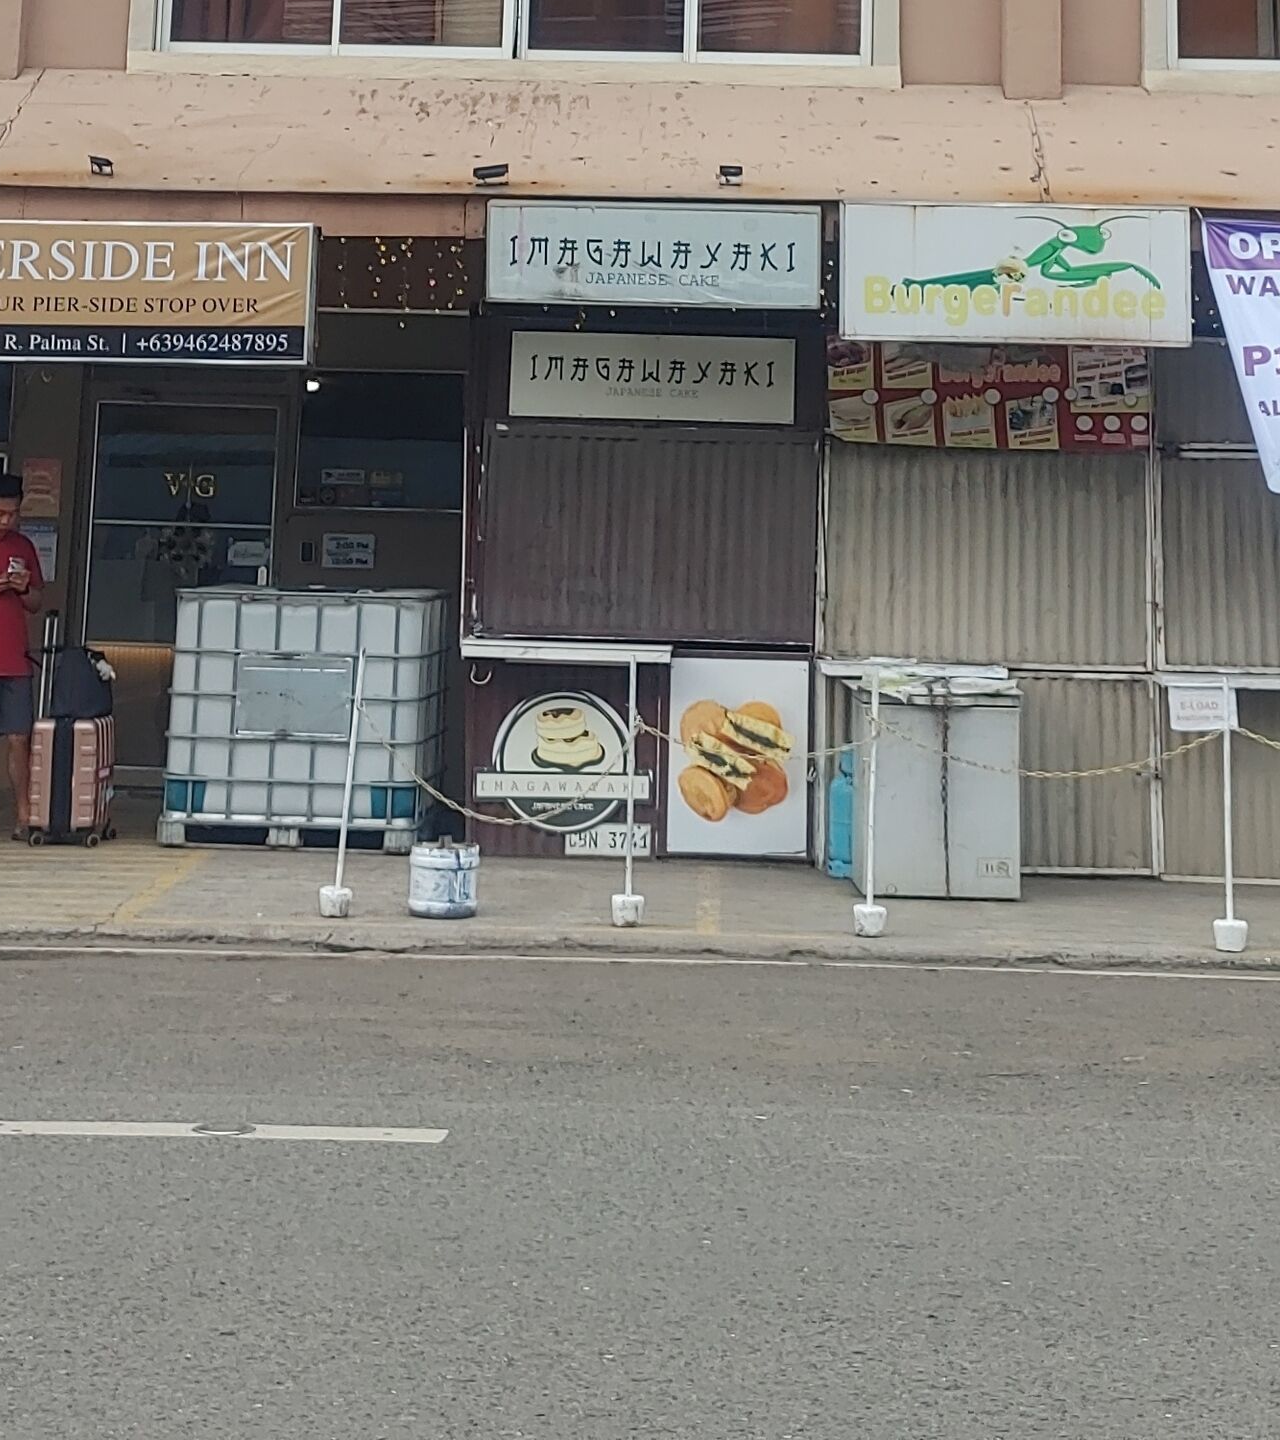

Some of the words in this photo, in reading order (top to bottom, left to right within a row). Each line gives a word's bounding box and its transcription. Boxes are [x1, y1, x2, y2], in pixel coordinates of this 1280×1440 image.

[194, 240, 298, 284] INN
[509, 235, 796, 273] IMAGAWAYAKI
[585, 272, 668, 287] JAPANESE
[679, 274, 720, 288] CAKE
[32, 295, 139, 313] PIER-SIDE
[143, 296, 200, 314] STOP
[201, 297, 260, 315] OVER
[863, 275, 1166, 326] Burgerandee
[3, 333, 24, 350] R.
[28, 333, 82, 351] Palma
[86, 334, 110, 352] St.
[135, 333, 289, 353] +639462487895
[529, 354, 775, 388] IMAGAWAYAKI
[164, 473, 215, 498] VG
